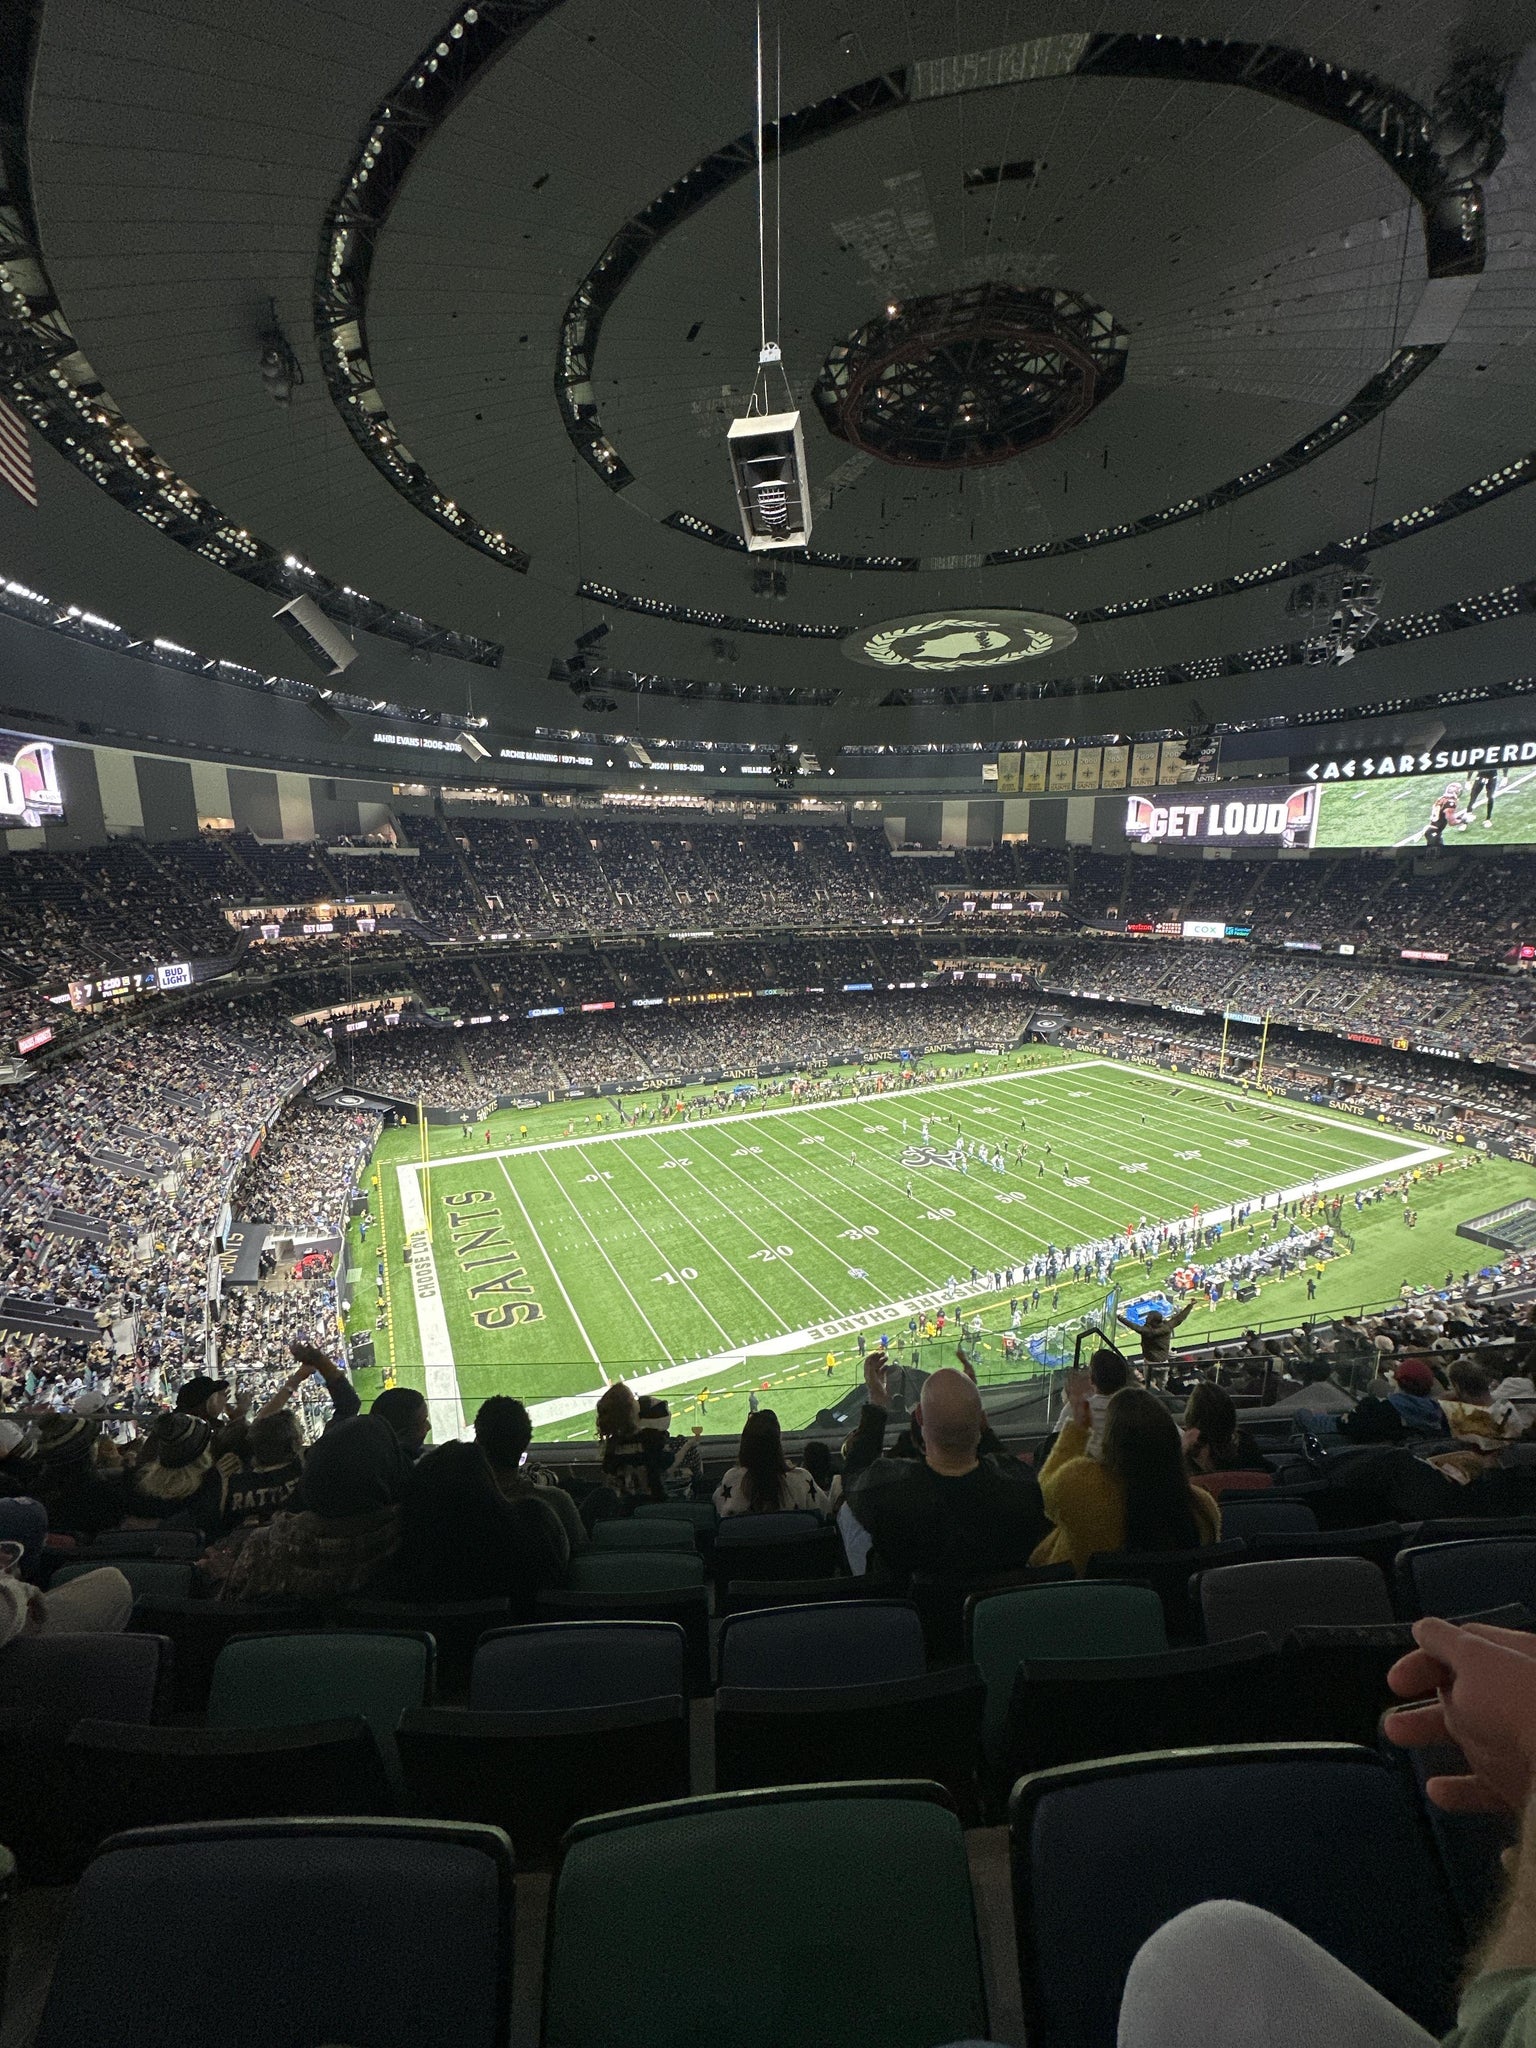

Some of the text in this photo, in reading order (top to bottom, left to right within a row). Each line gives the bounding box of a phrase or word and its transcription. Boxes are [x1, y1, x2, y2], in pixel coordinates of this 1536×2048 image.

[373, 733, 396, 744] JAHRI
[396, 735, 419, 747] EVANS
[500, 749, 525, 760] ARCHIE
[526, 752, 558, 763] MANNING
[1306, 742, 1536, 780] CAESARS SUPERD
[741, 766, 761, 774] WILLIE
[1149, 802, 1289, 837] GET LOUD
[1194, 926, 1217, 934] COX
[164, 967, 184, 977] BUD
[162, 975, 188, 986] LIGHT
[1175, 1005, 1205, 1016] Ochsner
[1347, 1033, 1382, 1046] verizon
[924, 1043, 952, 1054] SAINTS
[1076, 1044, 1101, 1055] SAINTS
[1405, 1045, 1461, 1059] CAESARS
[863, 1050, 894, 1063] SAINTS
[1131, 1054, 1157, 1067] SAINTS
[723, 1067, 758, 1080] SAINTS
[642, 1076, 682, 1092] SAINTS
[1256, 1083, 1288, 1097] SAINTS
[477, 1100, 499, 1122] SAINTS
[1329, 1100, 1365, 1116] SAINTS
[1415, 1091, 1533, 1121] SUPERDOME
[1413, 1122, 1454, 1140] SAINTS
[664, 1157, 693, 1169] 20
[585, 1170, 614, 1183] 10
[994, 1191, 1027, 1204] 50
[926, 1206, 957, 1221] 40
[844, 1225, 880, 1241] 30
[220, 1232, 245, 1275] SAINTS
[441, 1189, 547, 1330] SAINTS
[755, 1245, 794, 1262] 20
[410, 1230, 437, 1299] CHOOSE LOVE
[660, 1267, 699, 1286] 10
[806, 1307, 902, 1341] CHANGE
